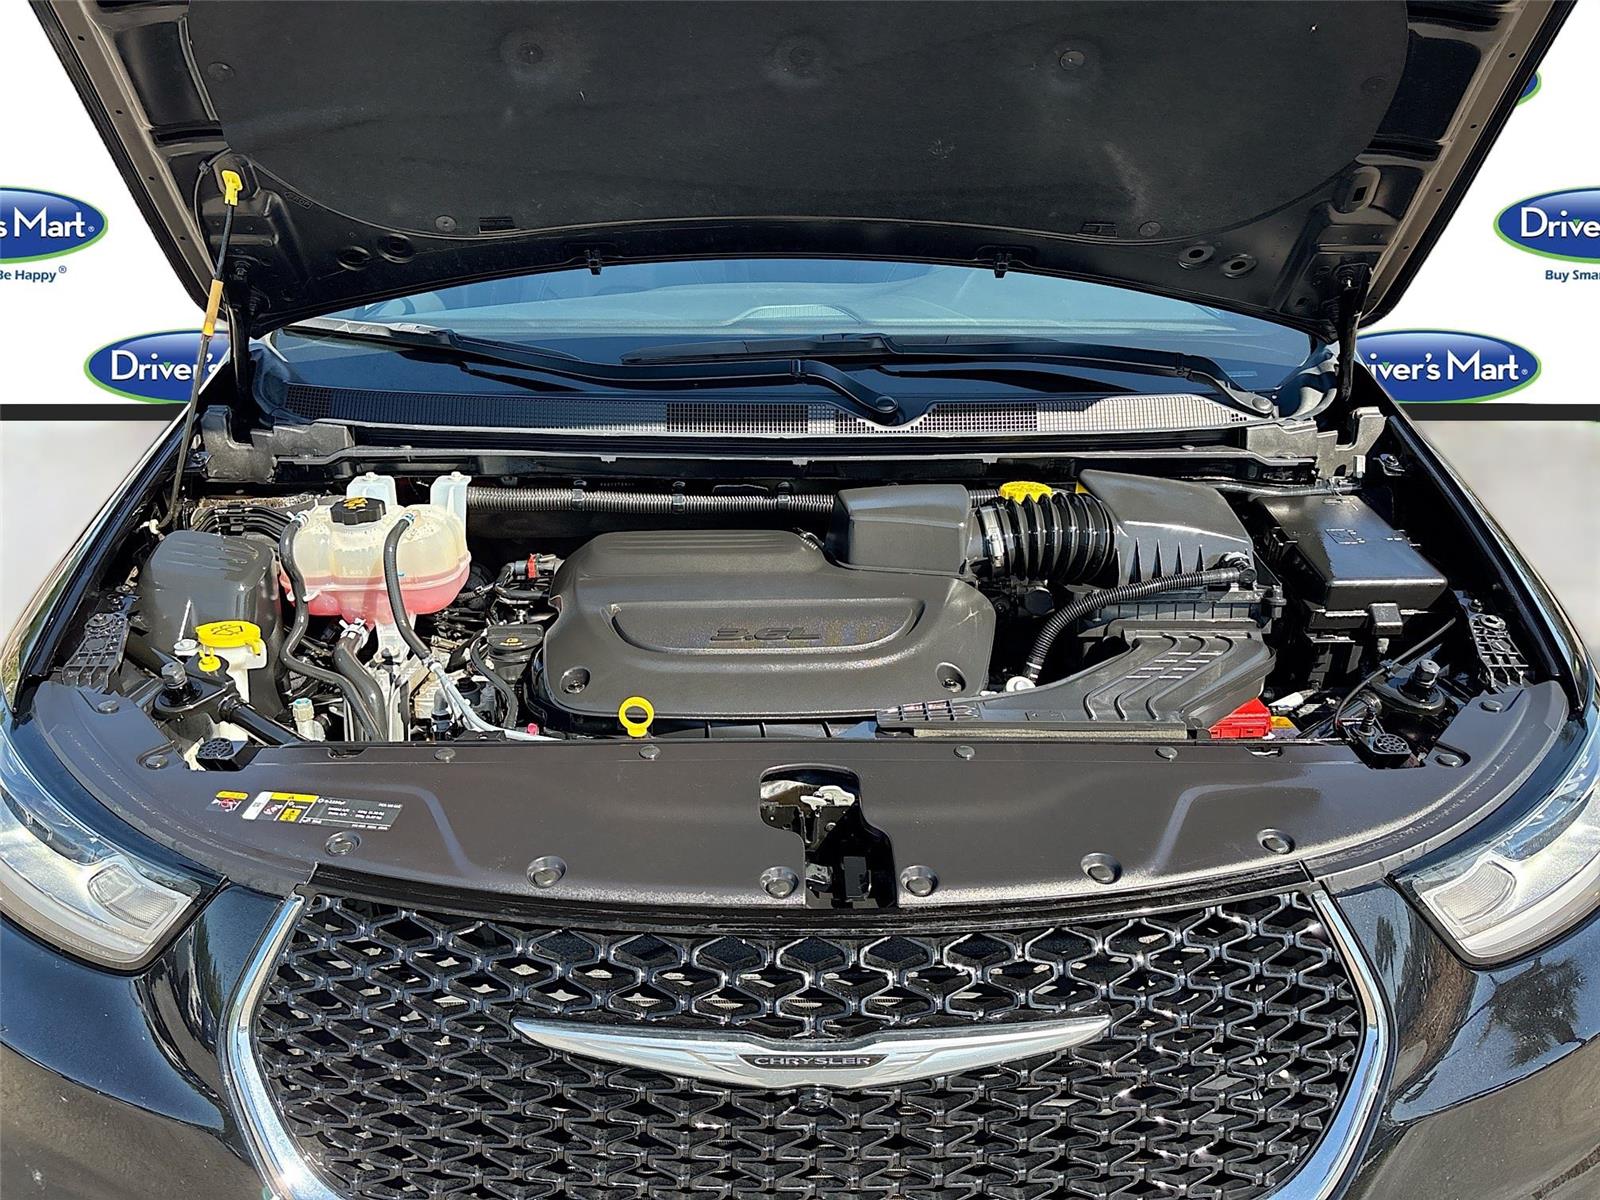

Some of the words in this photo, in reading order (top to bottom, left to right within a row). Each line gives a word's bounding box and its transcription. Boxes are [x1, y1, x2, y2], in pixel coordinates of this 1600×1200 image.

[14, 206, 86, 238] Mart
[1520, 206, 1600, 238] Drive
[15, 270, 57, 283] Happy
[1545, 269, 1569, 283] Buy
[1572, 269, 1600, 281] Sma
[1366, 352, 1441, 381] iver's
[1447, 349, 1519, 381] Mart
[754, 1057, 871, 1065] CHRYSLER
